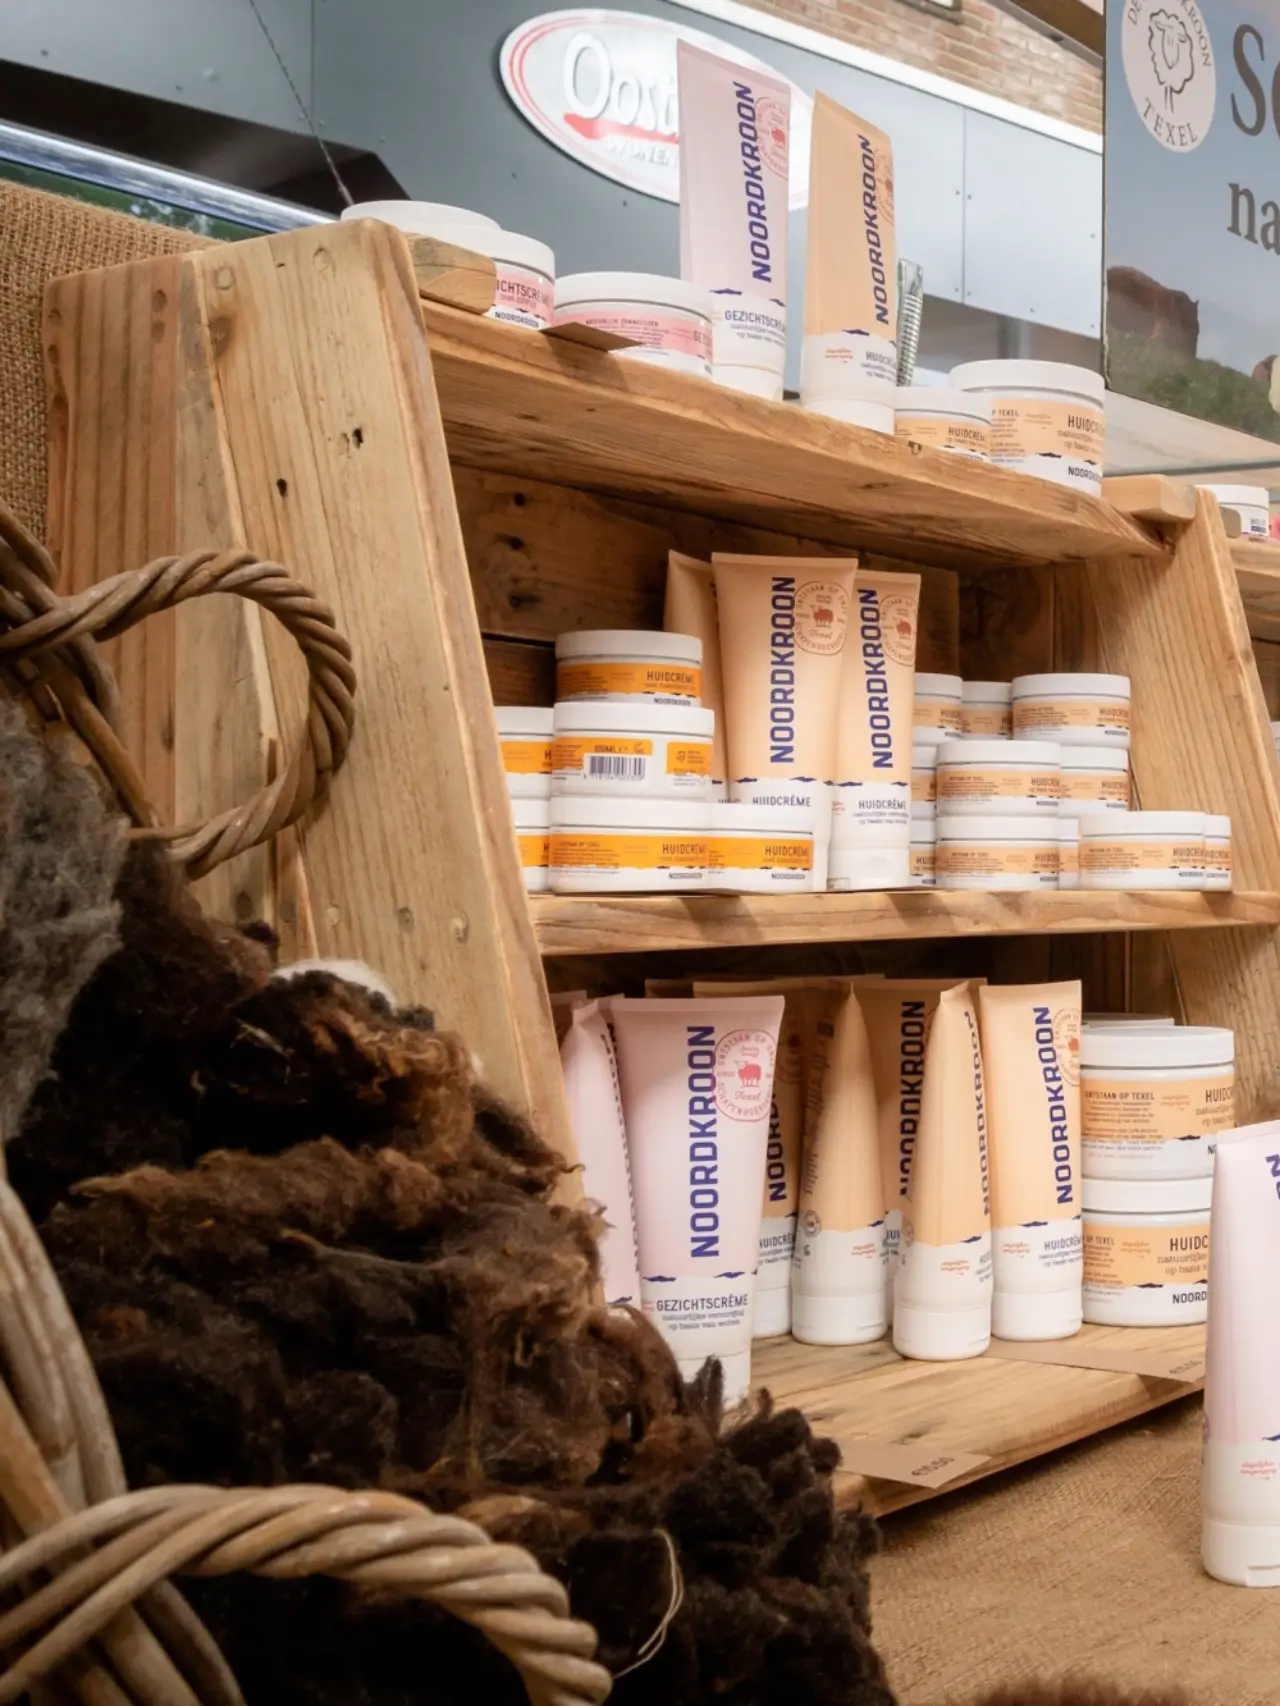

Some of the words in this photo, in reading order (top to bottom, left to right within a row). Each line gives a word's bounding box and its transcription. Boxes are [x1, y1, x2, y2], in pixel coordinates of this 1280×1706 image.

[732, 80, 772, 283] NOORDKROON
[1143, 97, 1198, 147] TEXEL
[856, 133, 890, 325] NOORDKROON
[770, 576, 796, 764] NOORDKROON
[857, 588, 894, 769] NOORDKROON
[686, 1026, 720, 1258] NOORDKROON
[900, 1000, 926, 1197] OORDKROON
[1032, 1006, 1074, 1205] NOORDKROON
[1131, 1091, 1155, 1100] TEXEL
[656, 1293, 748, 1312] GEZICHTSCRÈME
[1169, 1235, 1209, 1251] HUIDC
[1172, 1290, 1208, 1304] NOORD
